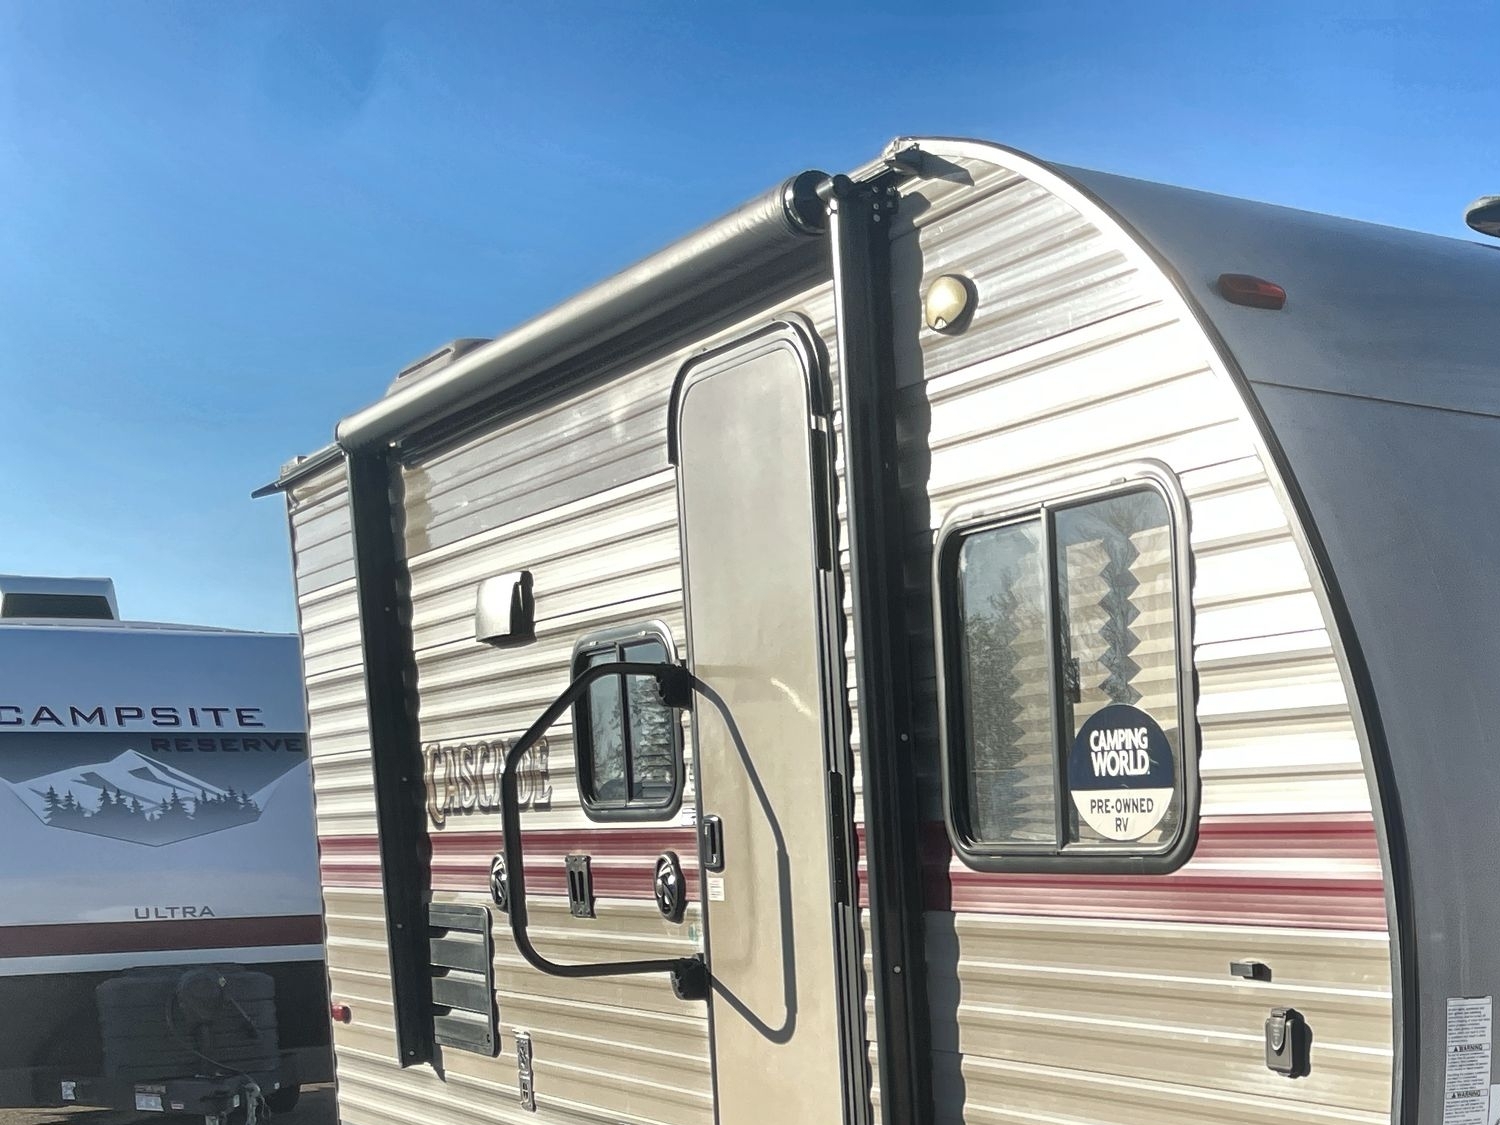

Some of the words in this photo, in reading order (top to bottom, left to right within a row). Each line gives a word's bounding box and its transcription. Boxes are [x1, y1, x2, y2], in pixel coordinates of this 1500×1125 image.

[0, 705, 265, 728] CAMPSITE
[150, 737, 305, 753] RESERVE
[1089, 726, 1149, 752] CAMPING
[1090, 798, 1154, 814] PRE-OWNED
[1115, 817, 1129, 833] RV
[134, 905, 216, 919] ULTRA
[1459, 1043, 1483, 1052] WARNING
[1456, 1089, 1481, 1099] WARNING
